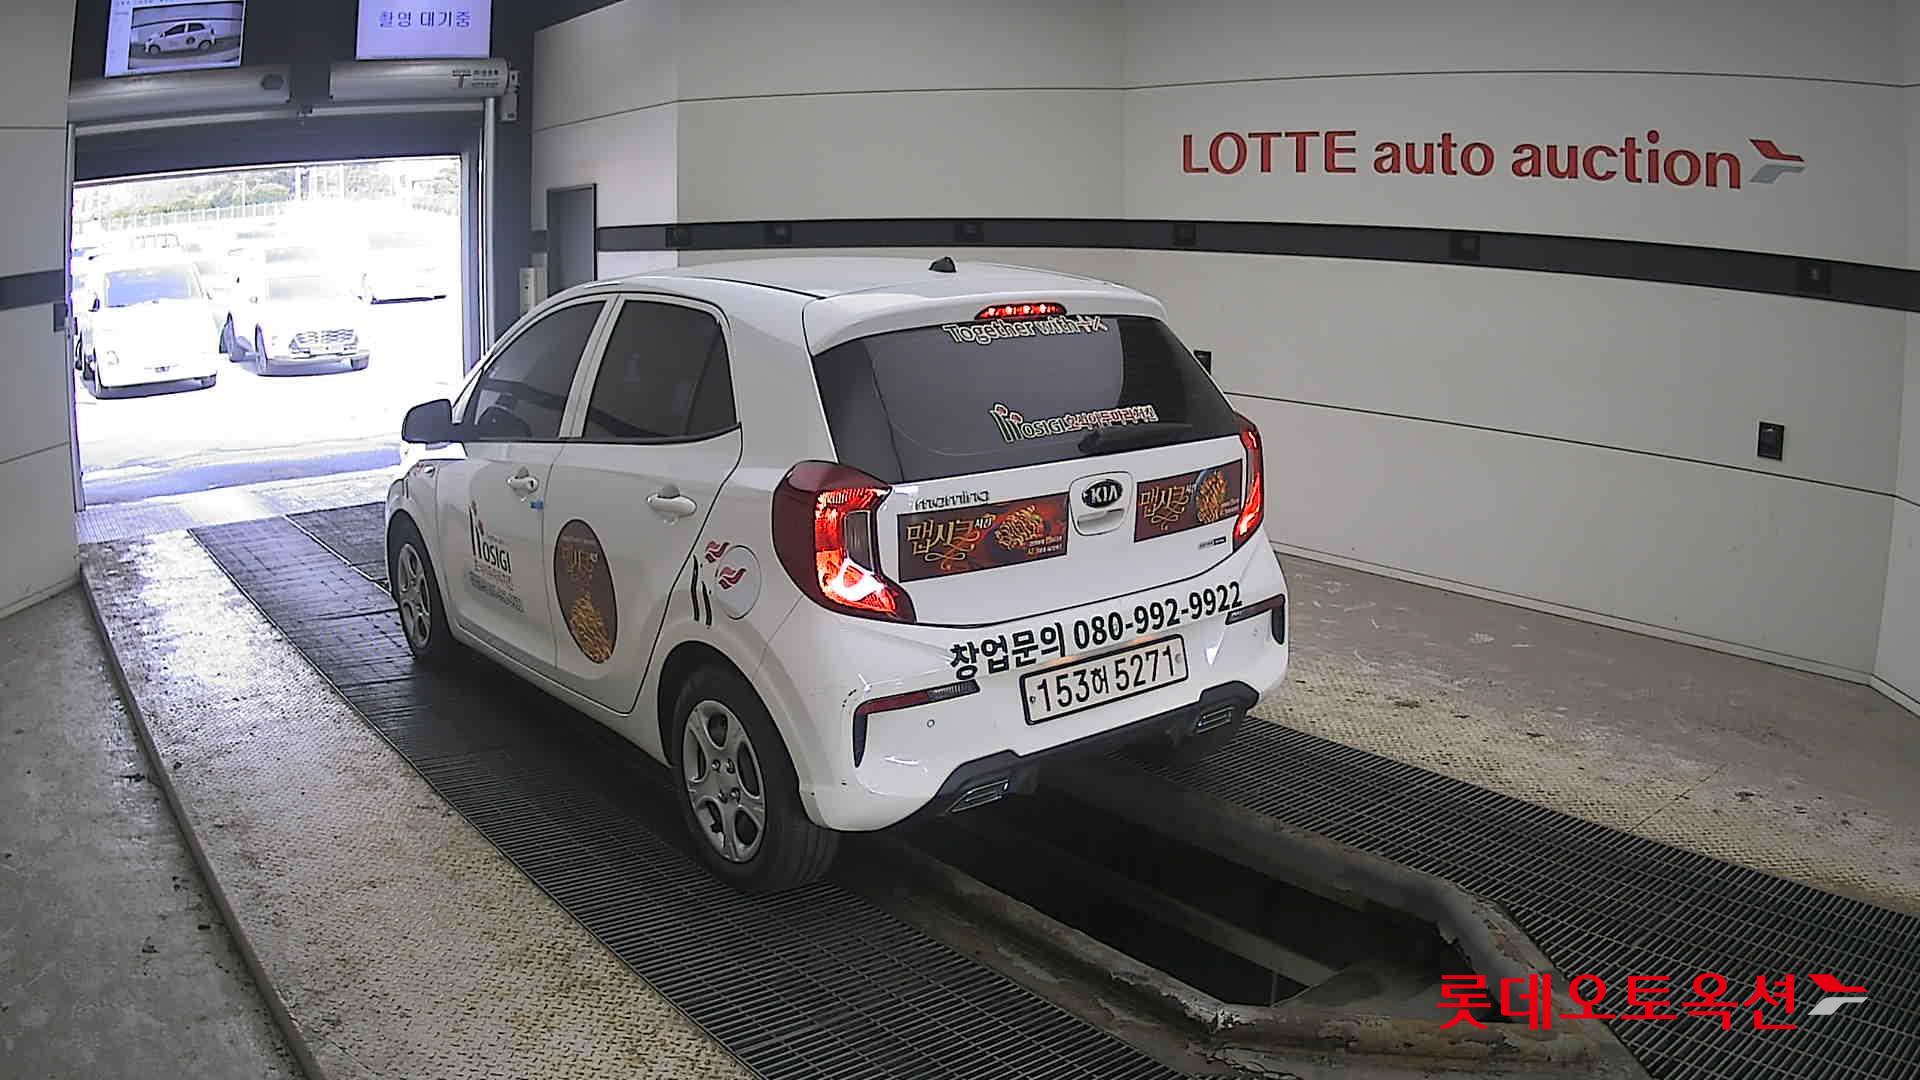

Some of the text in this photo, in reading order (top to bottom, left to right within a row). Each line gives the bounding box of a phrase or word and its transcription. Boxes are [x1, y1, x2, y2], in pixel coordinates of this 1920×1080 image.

[420, 10, 471, 28] 대기중
[1183, 129, 1742, 190] LOTTE auto auction
[942, 319, 1036, 345] Together
[1091, 485, 1118, 503] KIA
[950, 581, 1243, 681] 창업문의 080-992-9922
